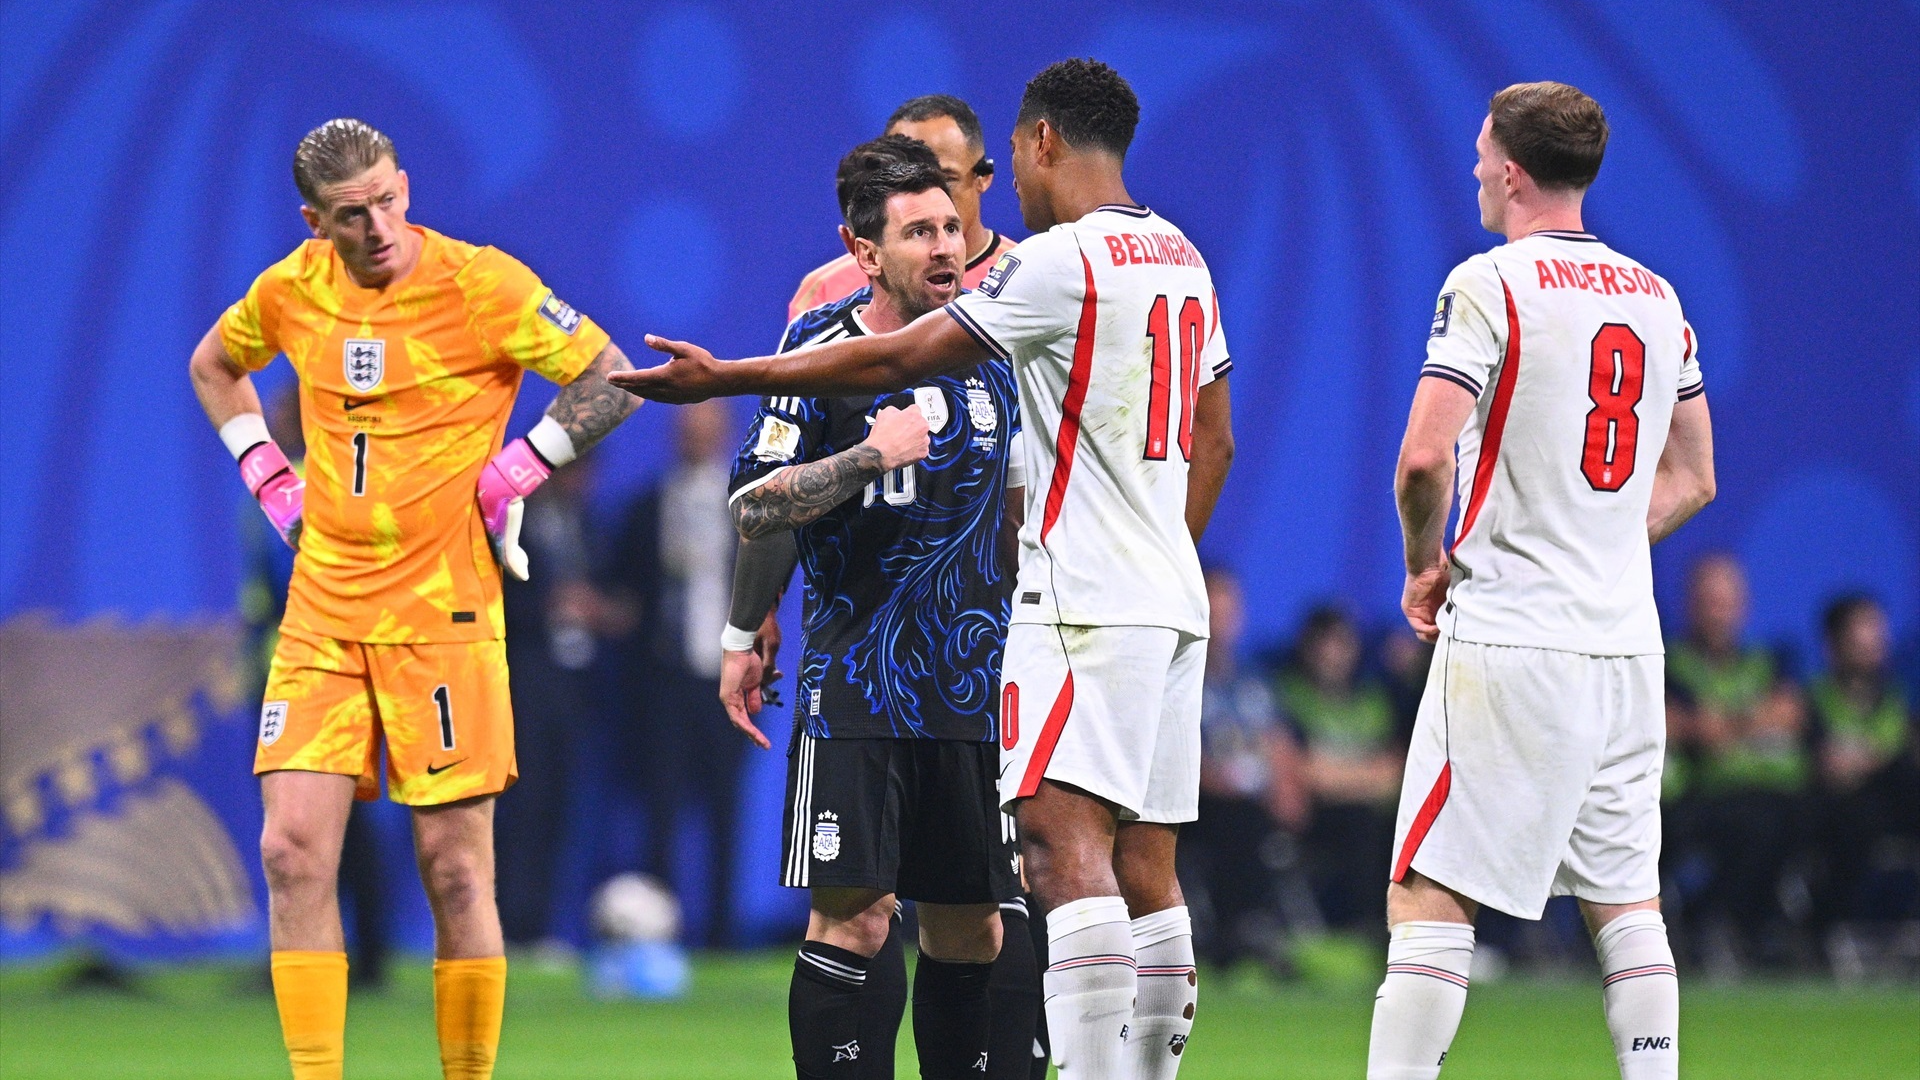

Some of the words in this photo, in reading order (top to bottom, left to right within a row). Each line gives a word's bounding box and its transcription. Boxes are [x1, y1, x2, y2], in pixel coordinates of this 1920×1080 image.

[1103, 233, 1204, 268] BELLINGHAM
[1535, 259, 1666, 299] ANDERSON
[1143, 294, 1204, 463] 10
[1580, 322, 1645, 492] 8
[352, 430, 368, 496] 1
[509, 464, 541, 490] JP
[864, 462, 917, 508] 0
[433, 684, 455, 750] 1
[1168, 1034, 1189, 1046] EN
[1632, 1036, 1671, 1051] ENG
